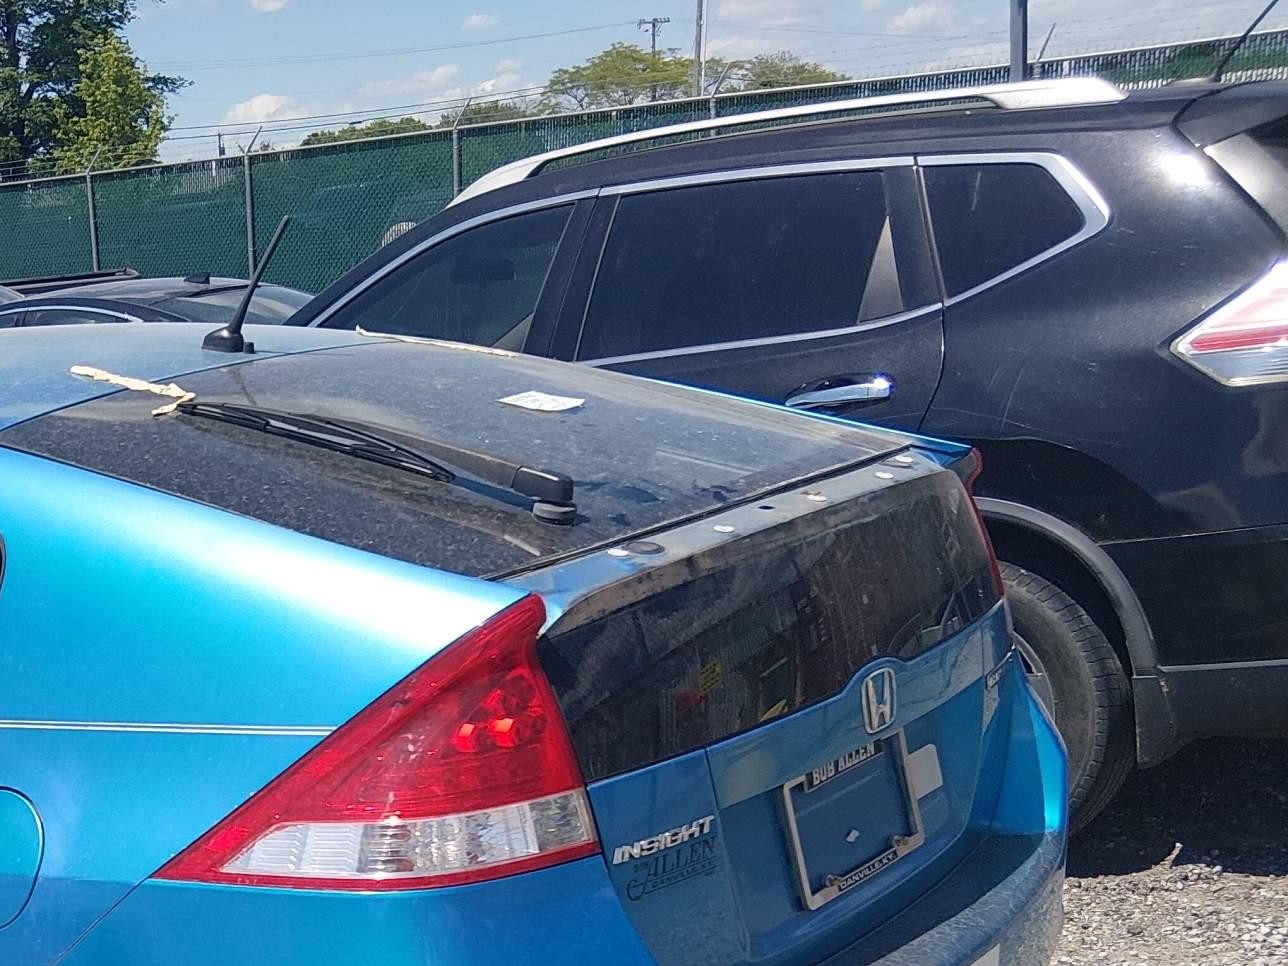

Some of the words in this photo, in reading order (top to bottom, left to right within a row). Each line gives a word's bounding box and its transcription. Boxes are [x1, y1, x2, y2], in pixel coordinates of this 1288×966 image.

[812, 762, 836, 786] BOB
[838, 742, 876, 774] ALLEN
[612, 815, 715, 865] INSIGHT
